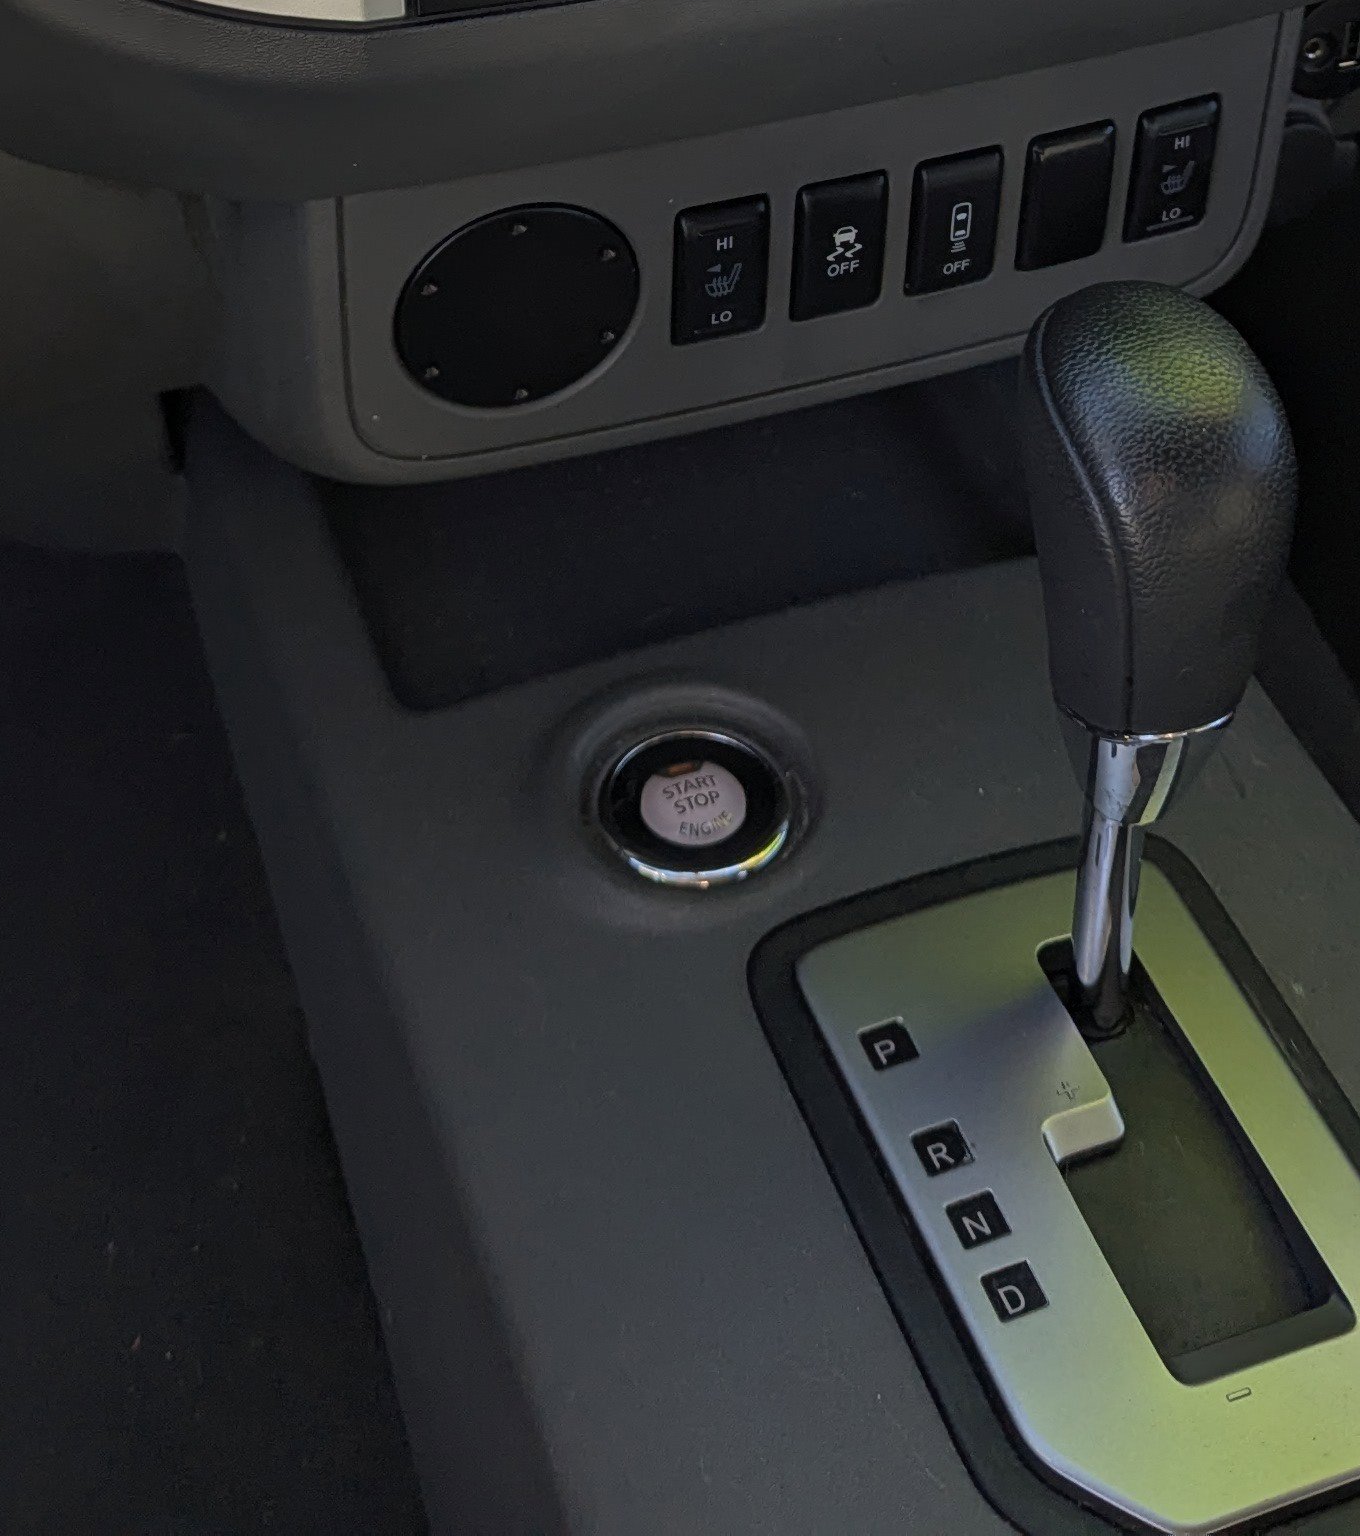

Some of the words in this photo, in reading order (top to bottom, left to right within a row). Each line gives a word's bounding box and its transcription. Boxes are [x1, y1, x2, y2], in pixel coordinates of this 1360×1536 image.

[1173, 135, 1191, 151] HI
[1161, 207, 1182, 222] LO
[715, 235, 734, 253] HI
[826, 259, 861, 278] OFF
[943, 258, 971, 276] OFF
[710, 310, 733, 326] LO
[662, 775, 717, 799] START
[674, 791, 720, 814] STOP
[873, 1038, 897, 1066] P
[926, 1141, 956, 1170] R
[961, 1210, 993, 1241] N
[996, 1284, 1027, 1316] D
